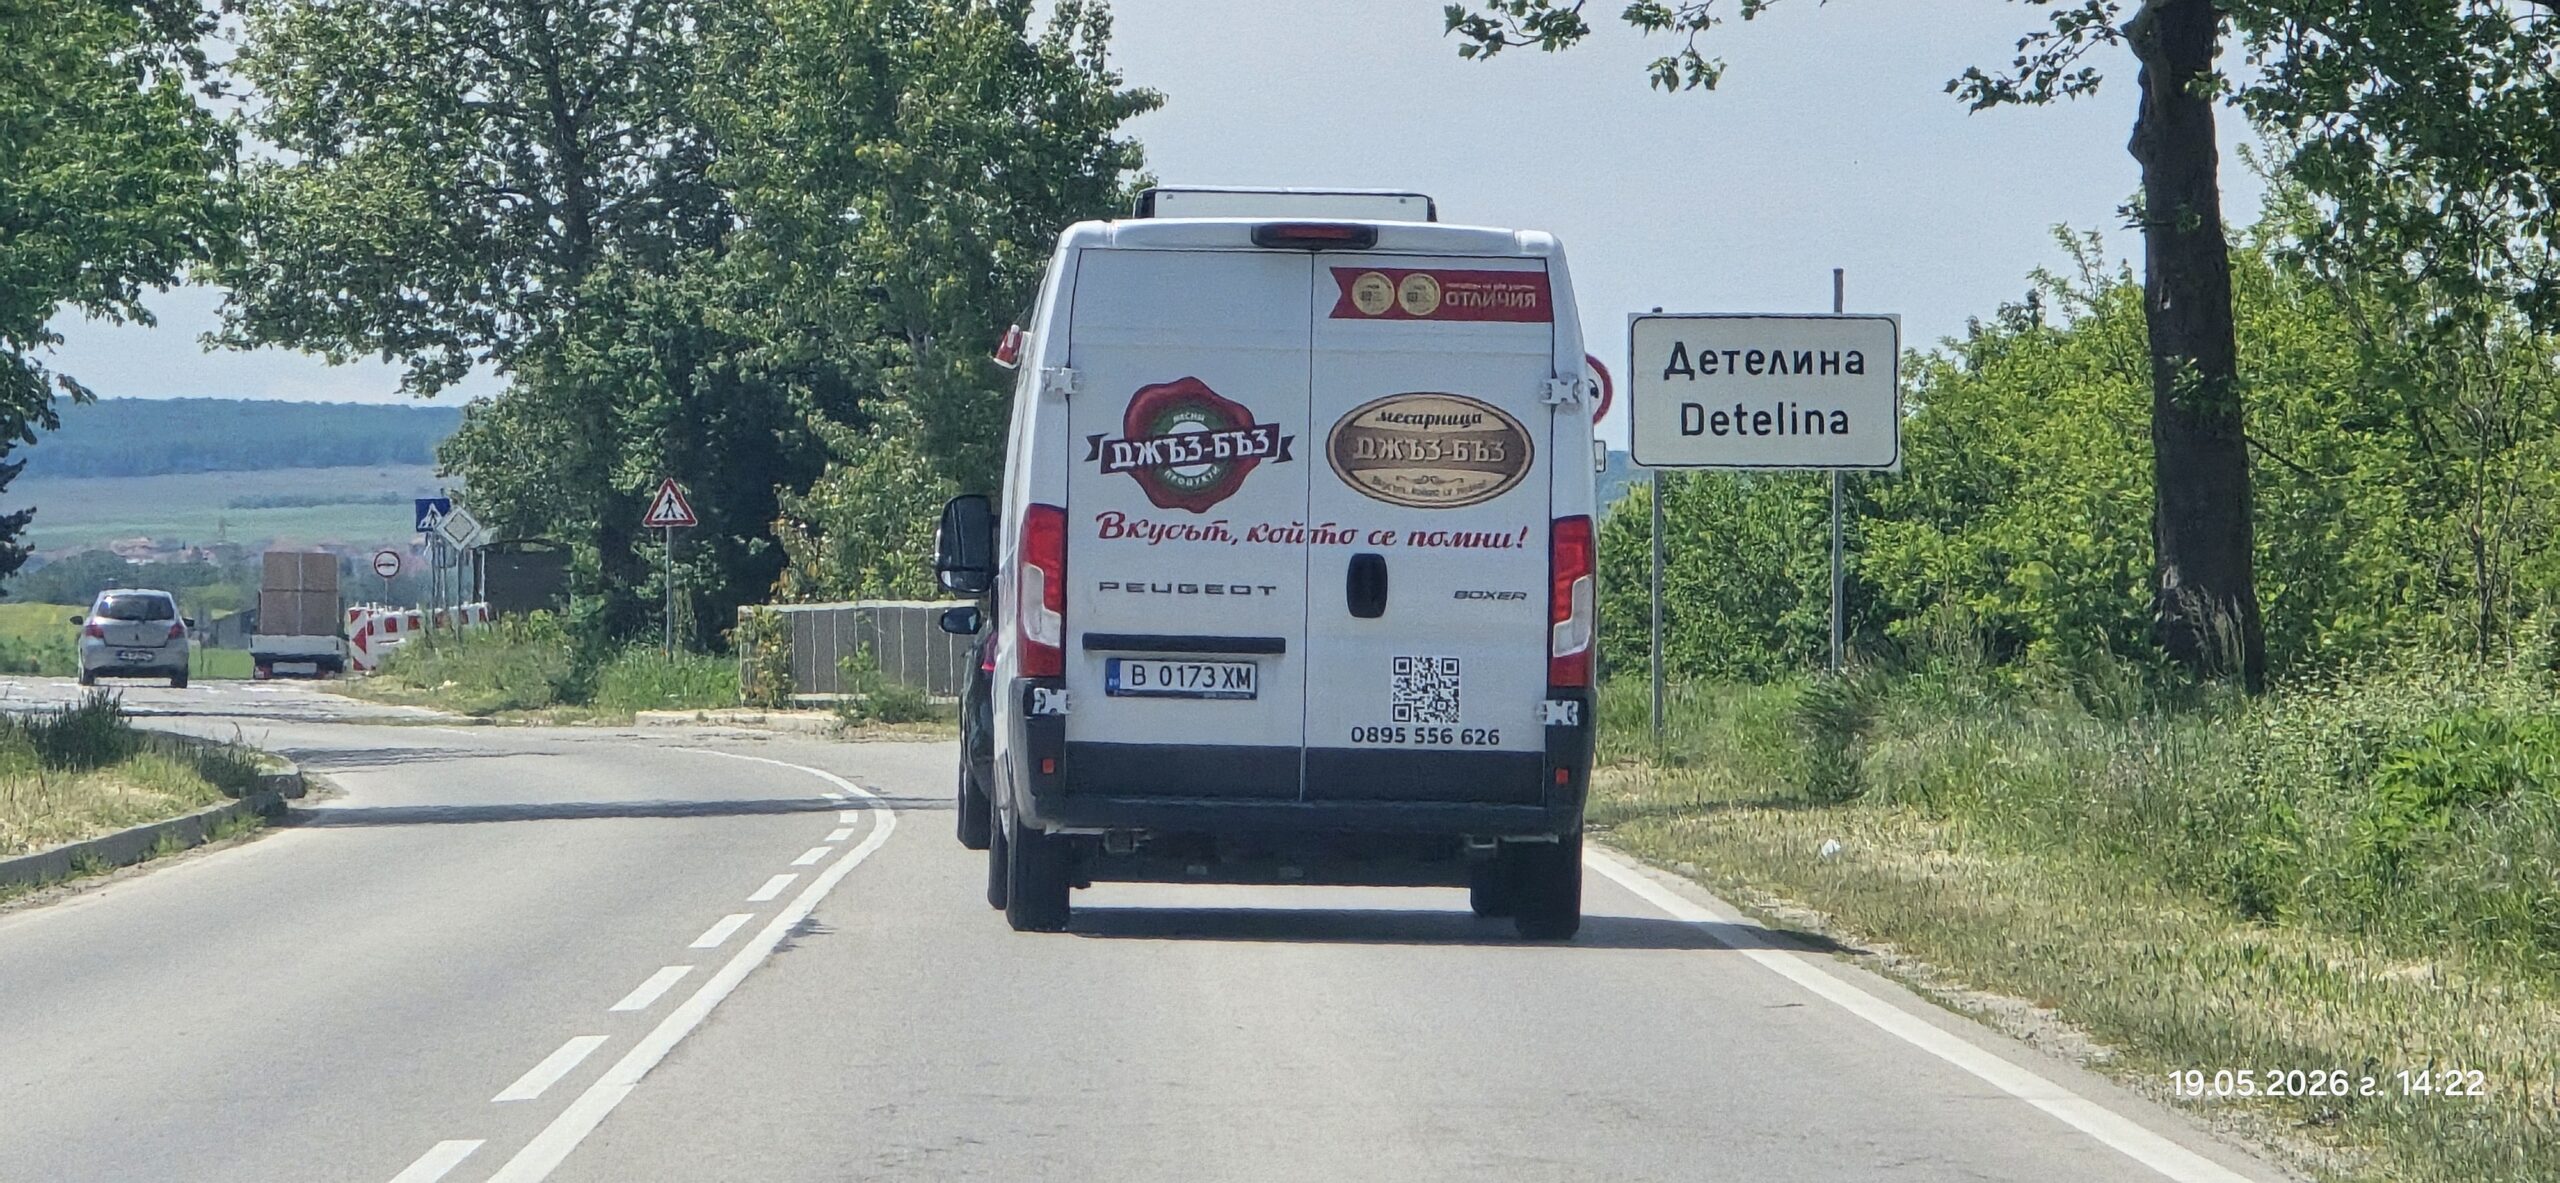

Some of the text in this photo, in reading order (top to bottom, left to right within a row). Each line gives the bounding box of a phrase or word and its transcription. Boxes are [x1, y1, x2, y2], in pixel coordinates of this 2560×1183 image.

[1445, 291, 1536, 308] ОТЛИЧИЯ
[1664, 341, 1865, 381] Детелина
[1375, 410, 1482, 429] месарница
[1681, 402, 1849, 436] Detelina
[1110, 428, 1270, 470] ДЖЪЗ-БЪЗ
[1354, 436, 1507, 463] ДЖЪЗ-БЪЗ
[1096, 511, 1529, 549] Вкусът, който се помни!
[1099, 581, 1277, 597] PEUGEOT
[1453, 590, 1528, 601] BOXER
[1159, 665, 1216, 688] 0173
[1351, 726, 1500, 746] 0895 556 626
